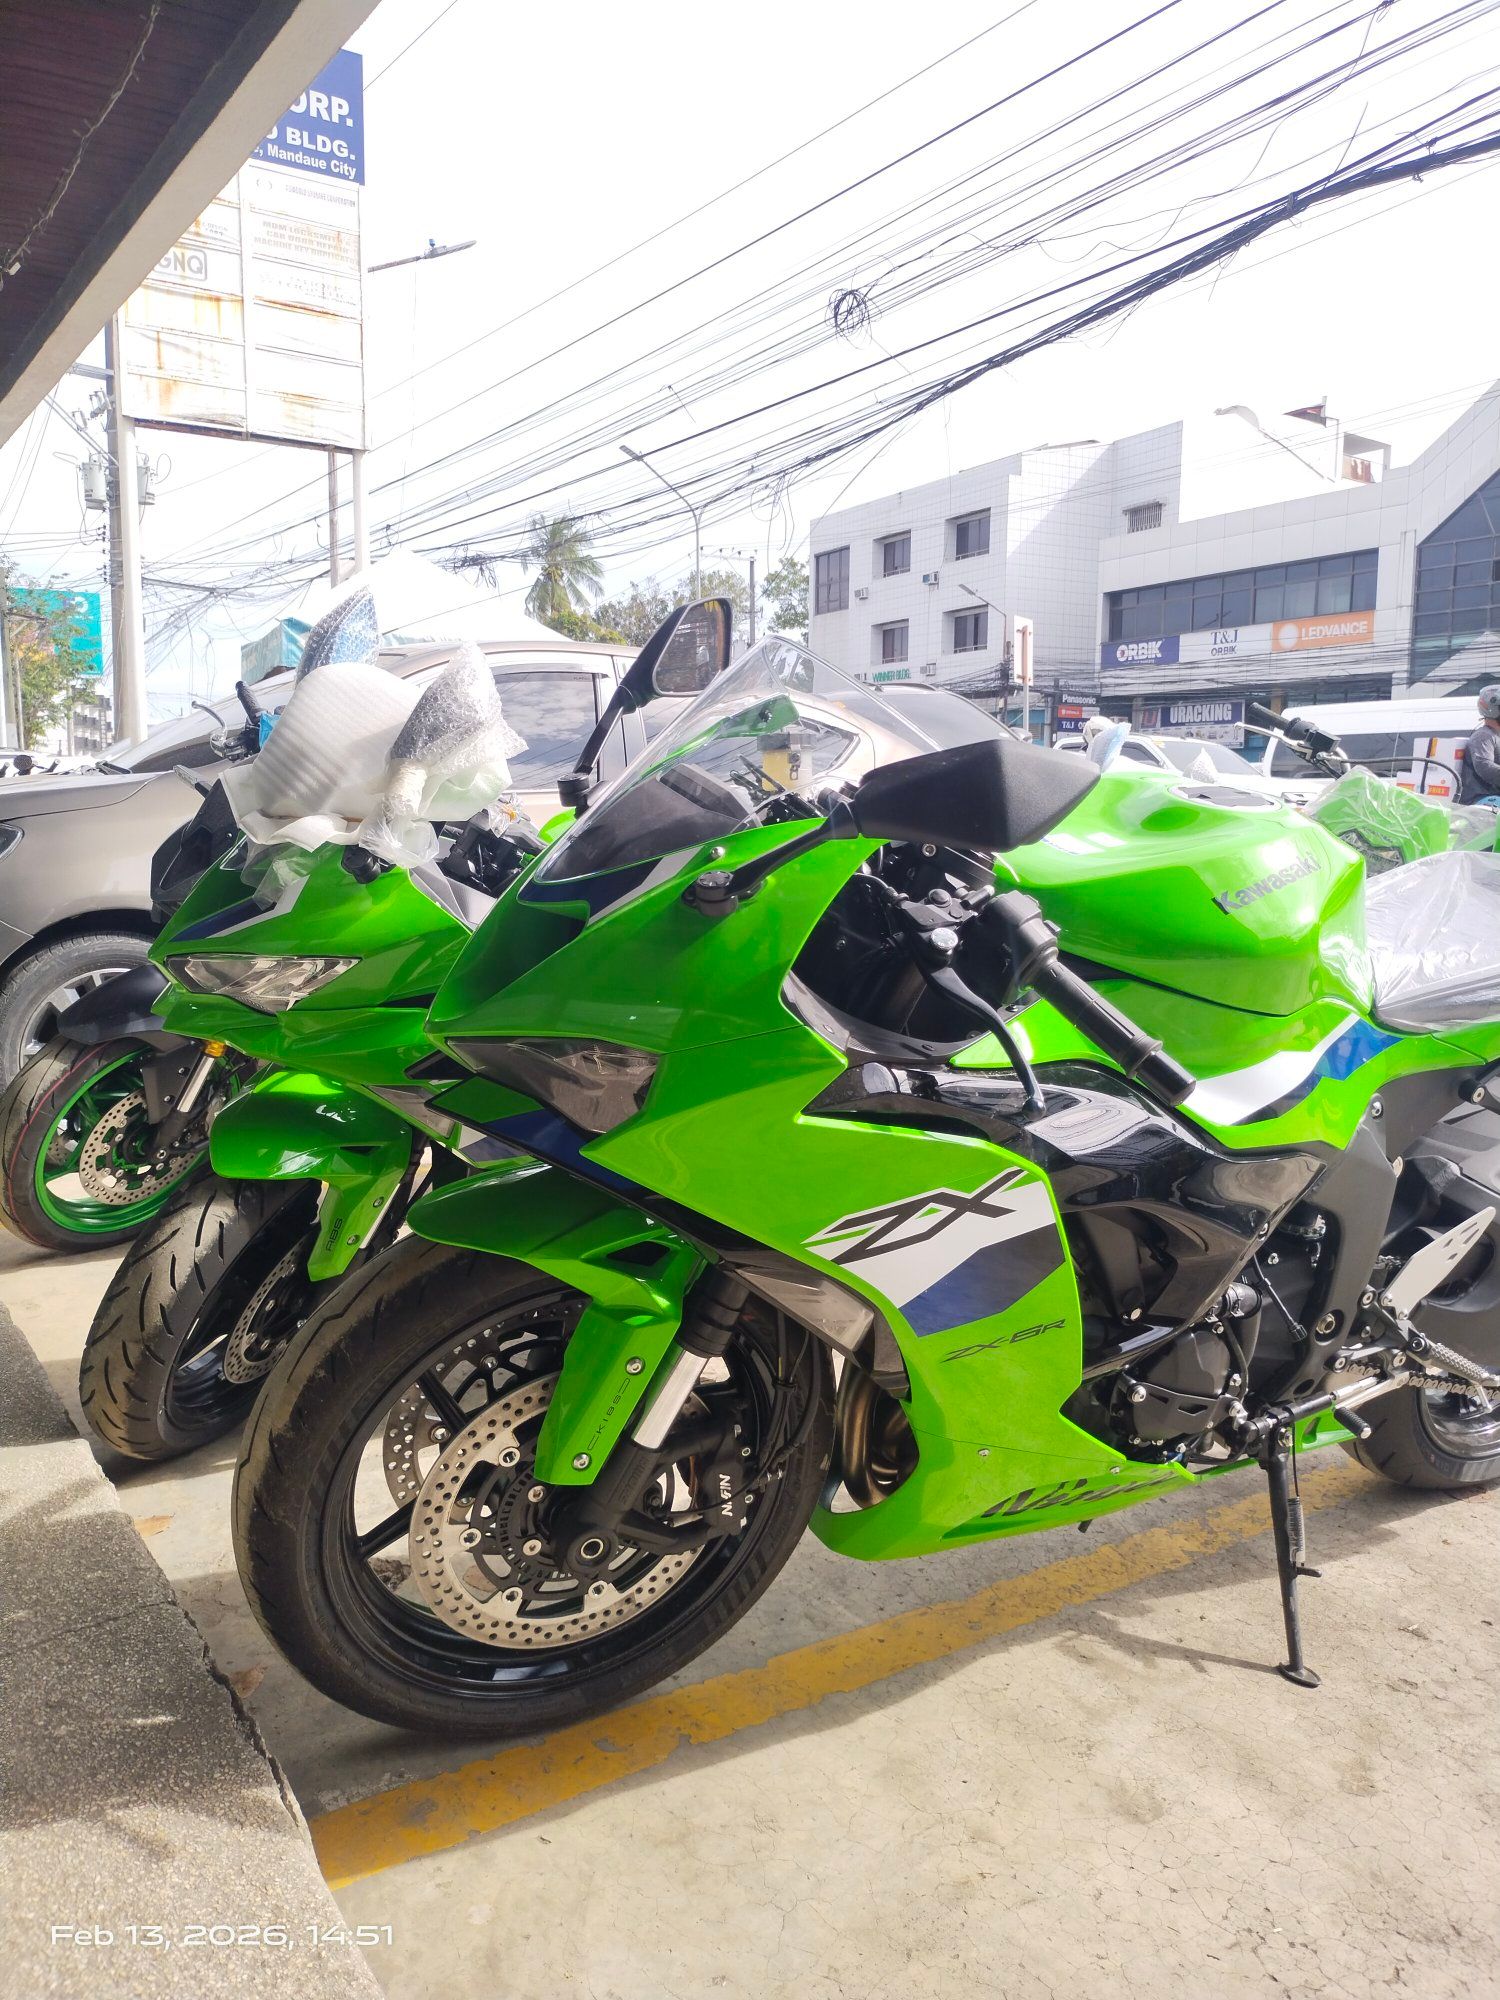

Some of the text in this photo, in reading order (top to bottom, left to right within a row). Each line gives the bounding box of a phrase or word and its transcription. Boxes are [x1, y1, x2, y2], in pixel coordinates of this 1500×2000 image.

[286, 126, 355, 160] BLDG.
[267, 143, 327, 170] Mandaue
[330, 159, 357, 180] City
[1211, 630, 1239, 645] T&J
[1302, 620, 1368, 640] LEDVANCE
[1116, 640, 1162, 661] ORBIK
[1211, 645, 1237, 656] ORBIK
[872, 671, 896, 682] WINNER
[1062, 694, 1096, 704] Panasonic
[1170, 703, 1232, 723] URACKING
[1062, 721, 1075, 729] T&J
[1211, 851, 1321, 915] Kawasaki
[822, 1167, 1028, 1266] ZX
[325, 1218, 343, 1251] ABS
[939, 1318, 1066, 1363] ZX-6R
[596, 1394, 621, 1434] KIBS
